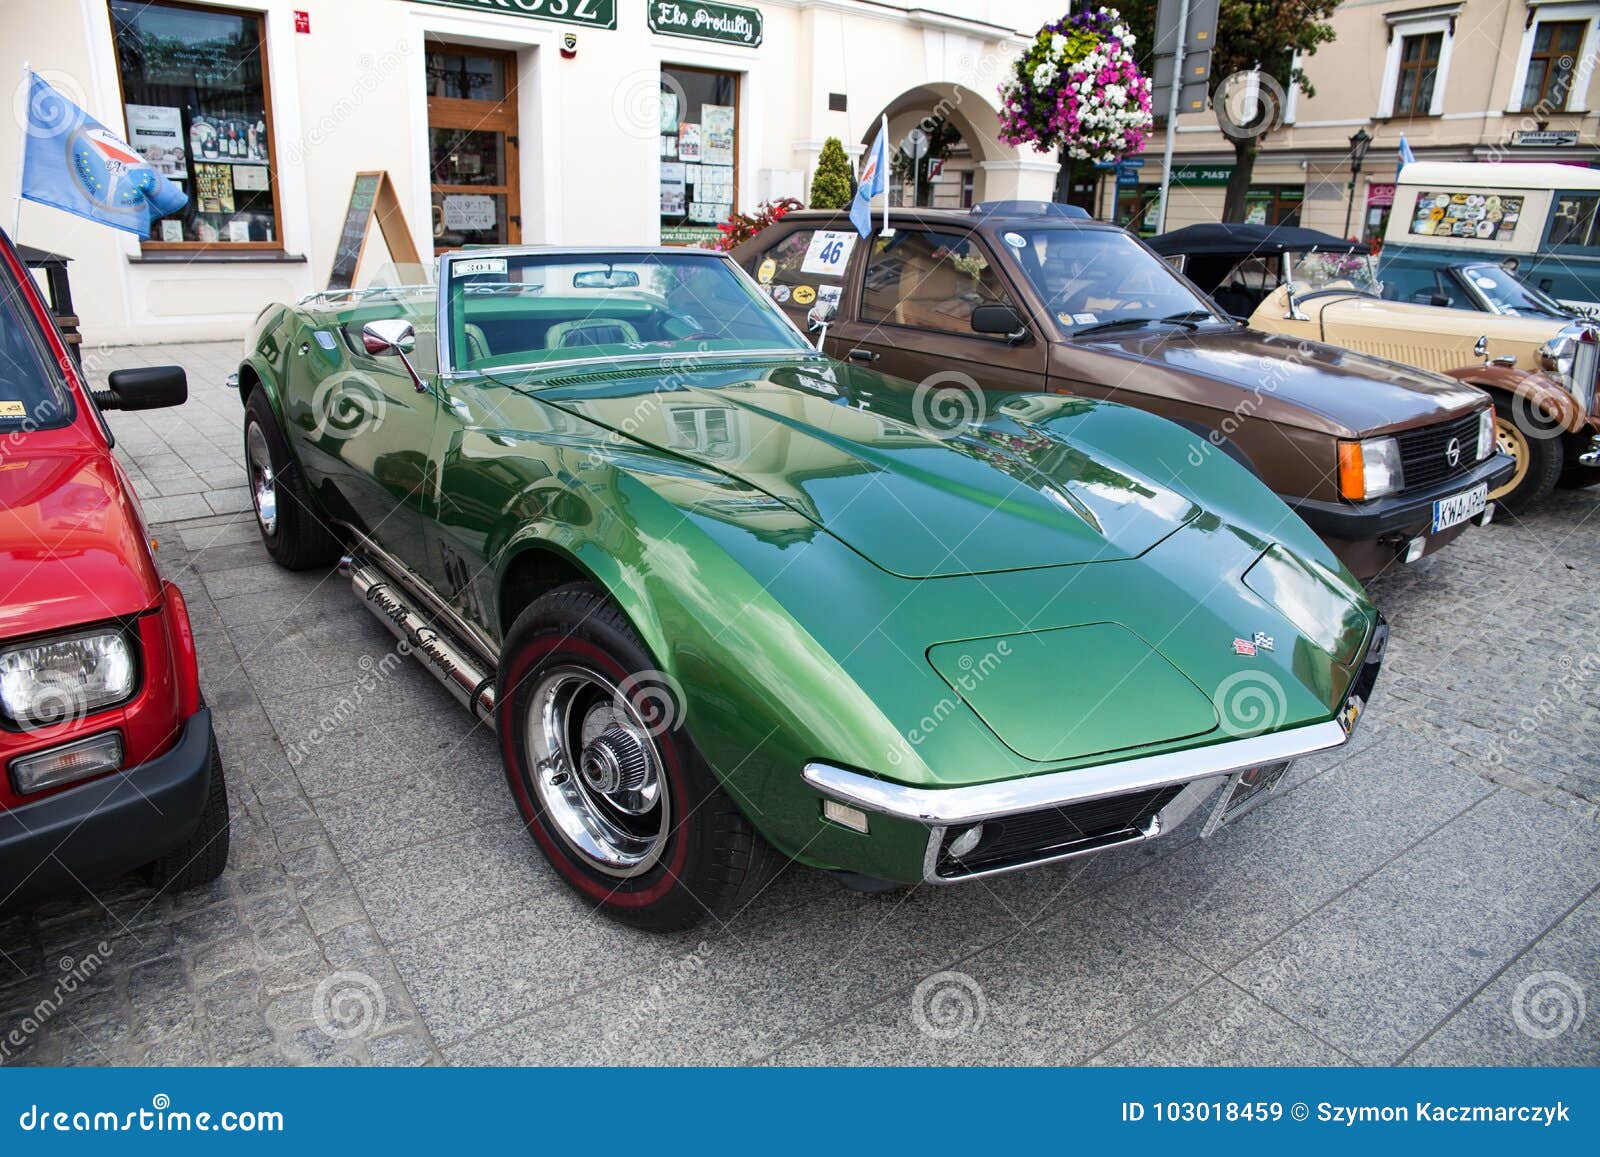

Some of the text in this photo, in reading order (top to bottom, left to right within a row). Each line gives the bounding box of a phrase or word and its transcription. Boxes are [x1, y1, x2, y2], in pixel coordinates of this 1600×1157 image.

[657, 2, 753, 42] Eko Produkty
[1201, 170, 1232, 179] PIAST
[819, 241, 844, 264] 46
